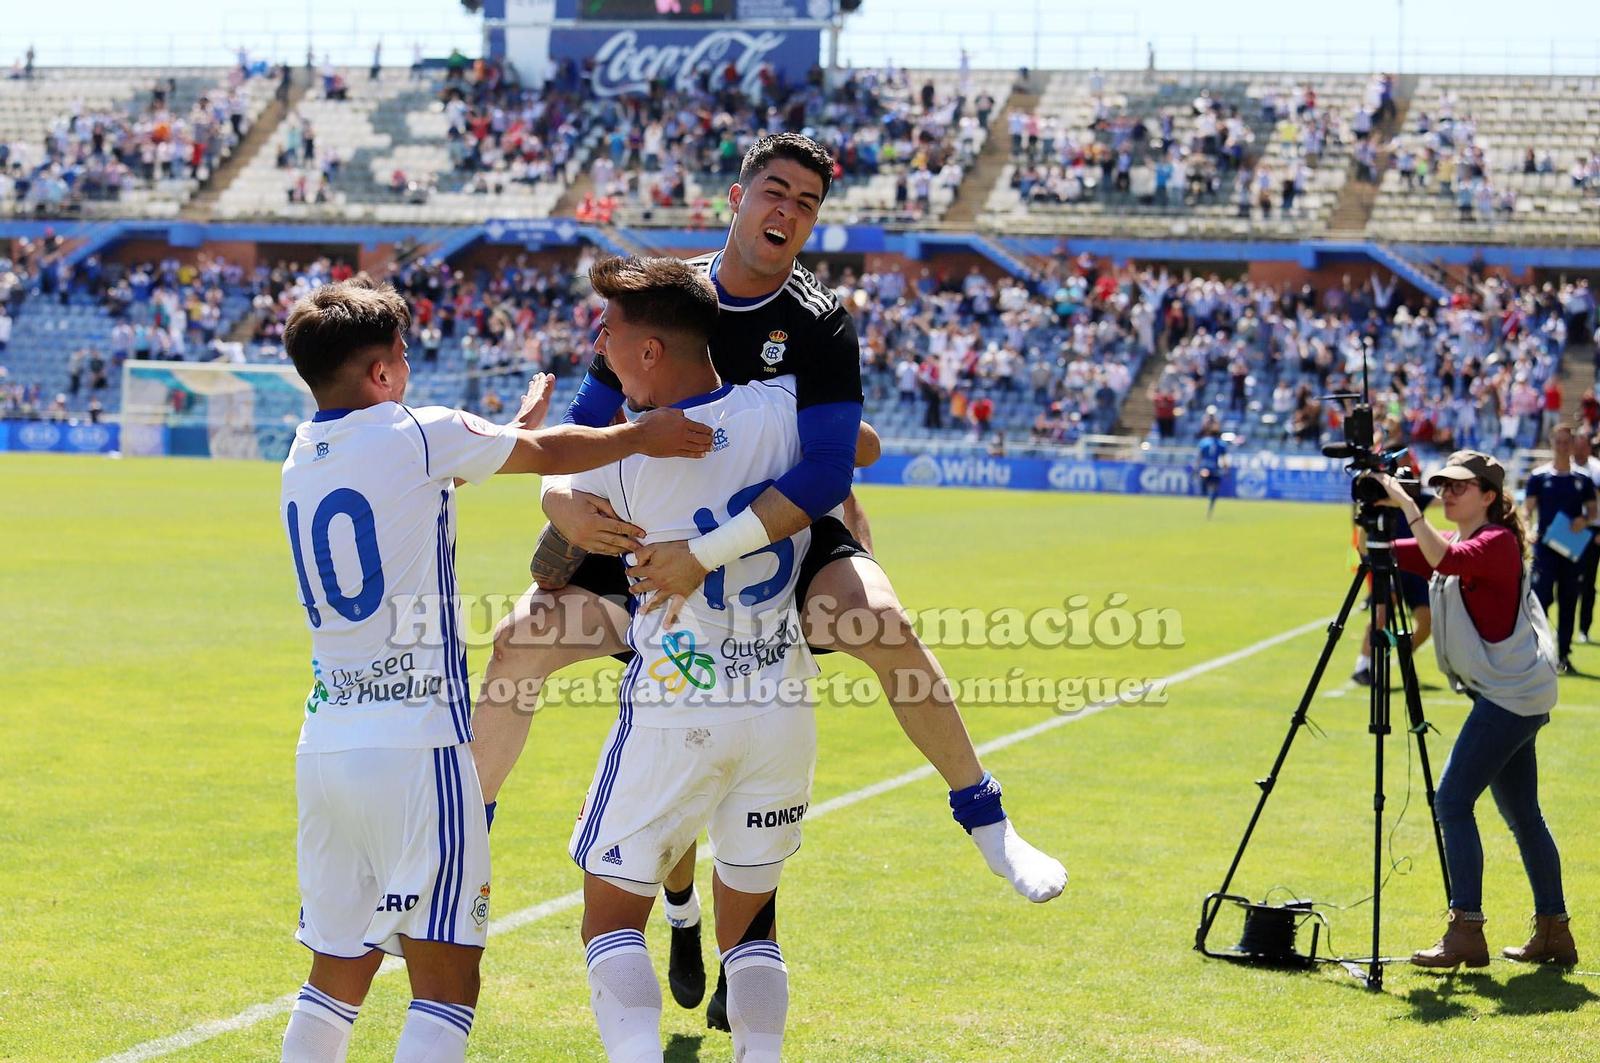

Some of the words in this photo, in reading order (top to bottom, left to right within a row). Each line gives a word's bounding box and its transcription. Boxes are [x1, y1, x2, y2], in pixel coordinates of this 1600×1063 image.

[286, 487, 385, 628] 10
[720, 637, 766, 661] Que
[371, 652, 416, 678] sea
[725, 660, 752, 679] de
[358, 675, 442, 704] Huelva
[747, 801, 808, 828] ROMER
